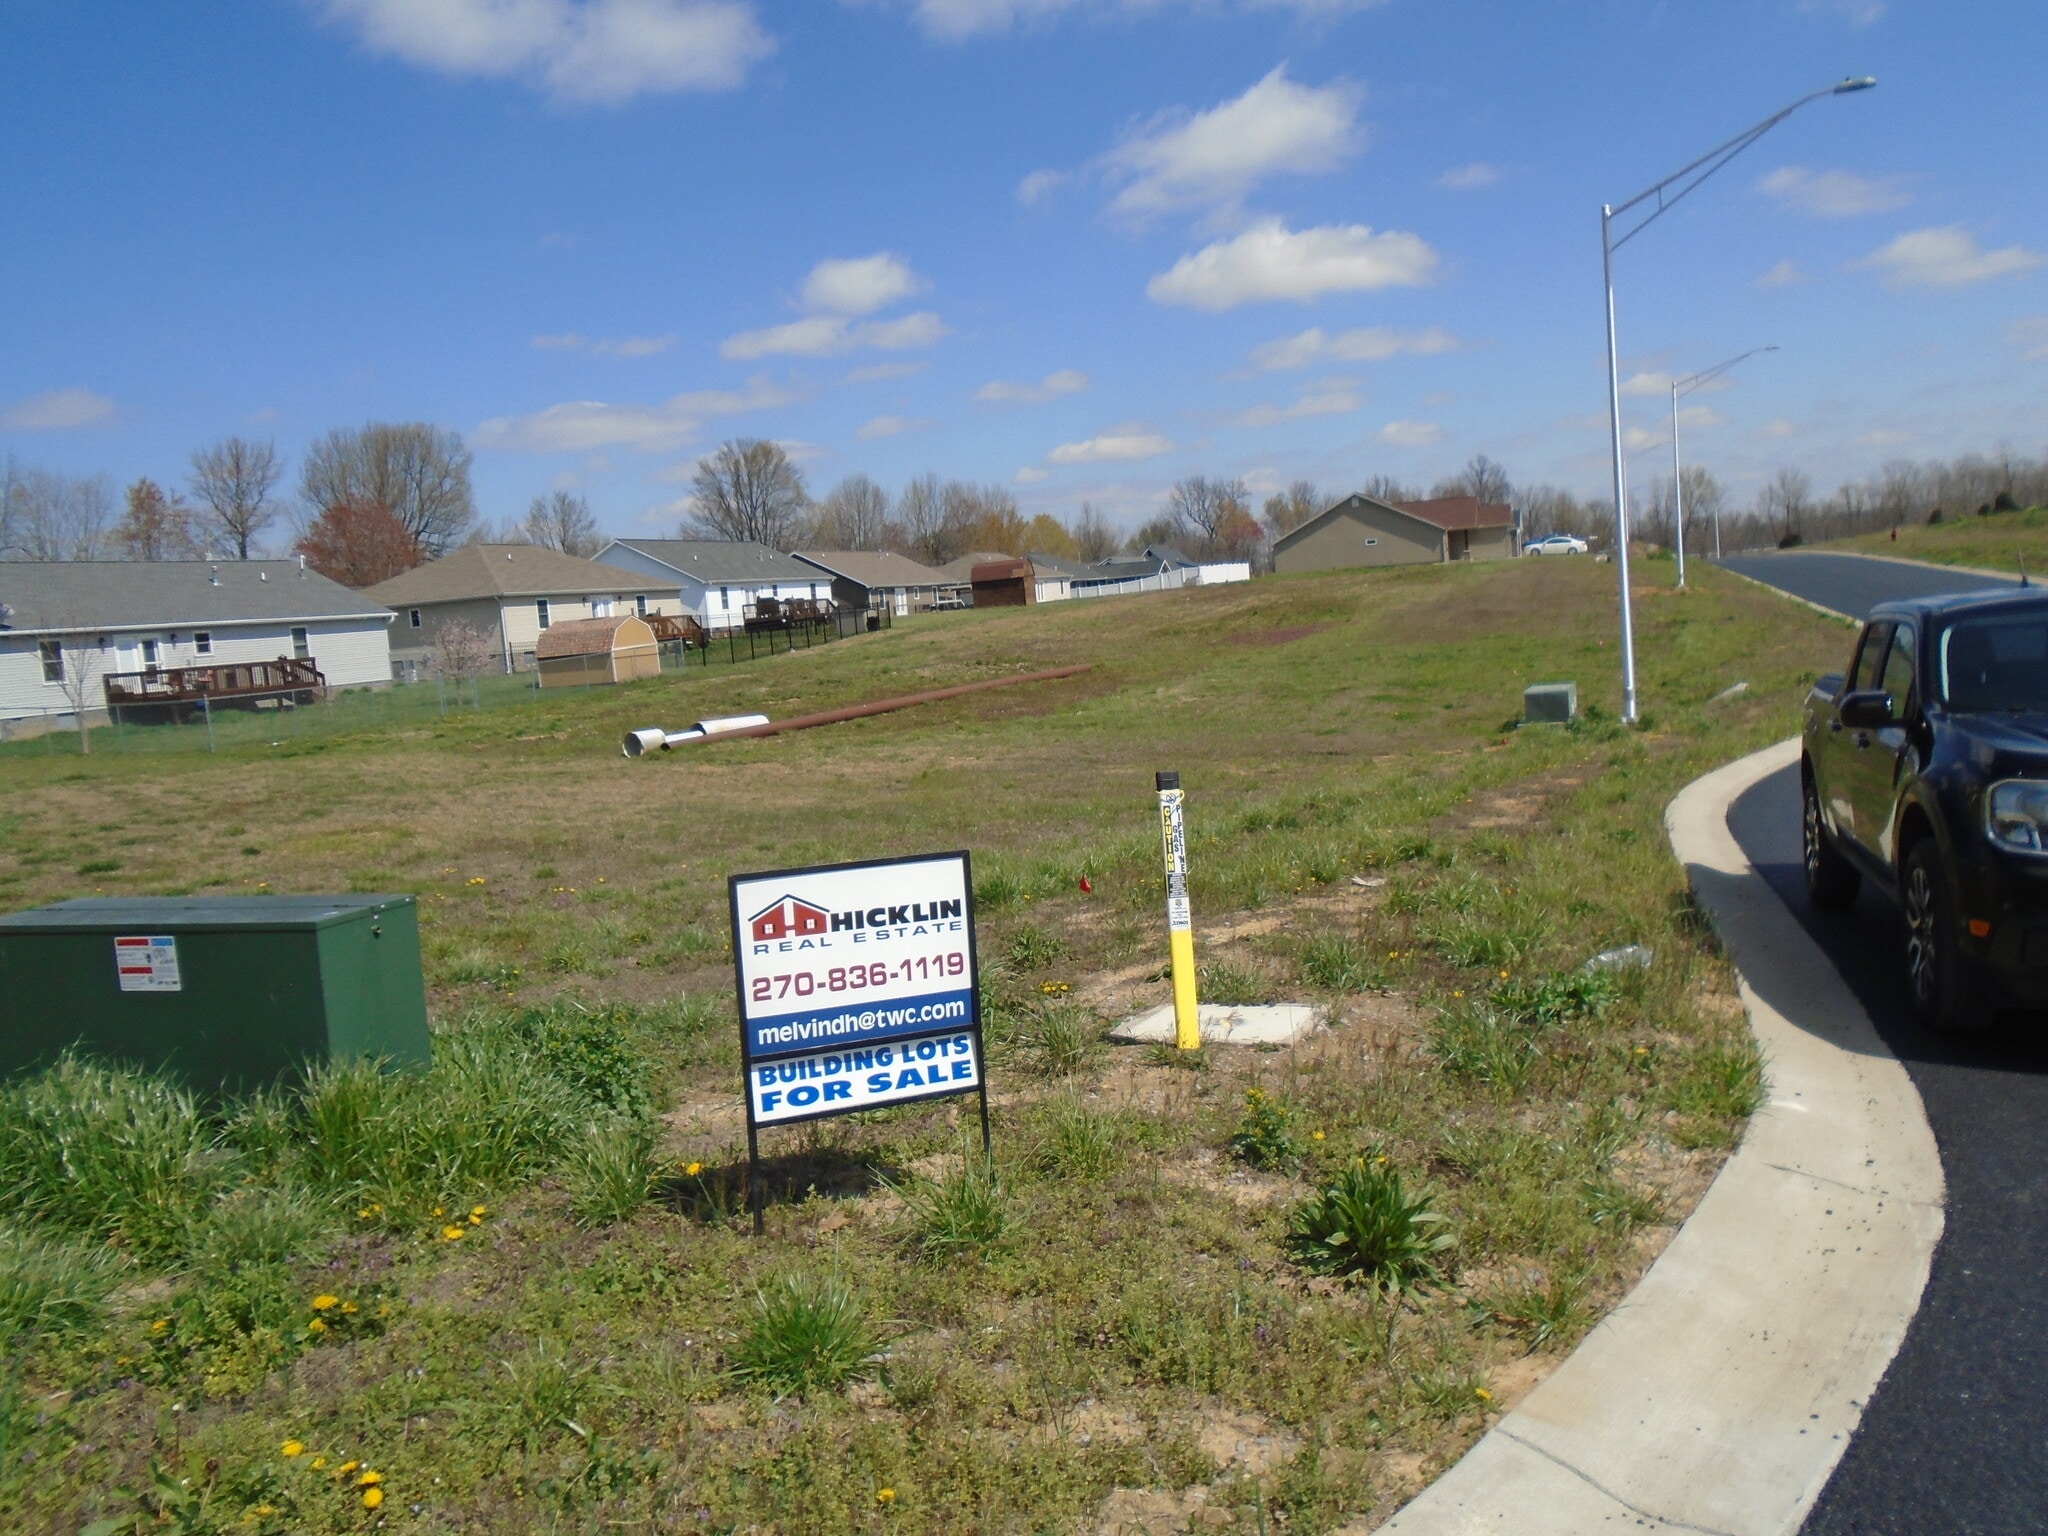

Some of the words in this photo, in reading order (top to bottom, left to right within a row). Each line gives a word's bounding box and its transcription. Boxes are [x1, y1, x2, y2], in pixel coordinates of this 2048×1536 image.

[1164, 806, 1175, 872] CAUTION
[1176, 804, 1186, 872] PIPELINE
[753, 937, 832, 955] REAL
[853, 920, 962, 943] ESTATE
[830, 898, 962, 932] HICKLIN
[752, 952, 964, 1002] 270-836-1119
[758, 1000, 965, 1045] melvindh@twc.com
[758, 1047, 894, 1087] BUILDING
[902, 1035, 969, 1063] LOTS
[761, 1080, 853, 1112] FOR
[867, 1059, 972, 1094] SALE
